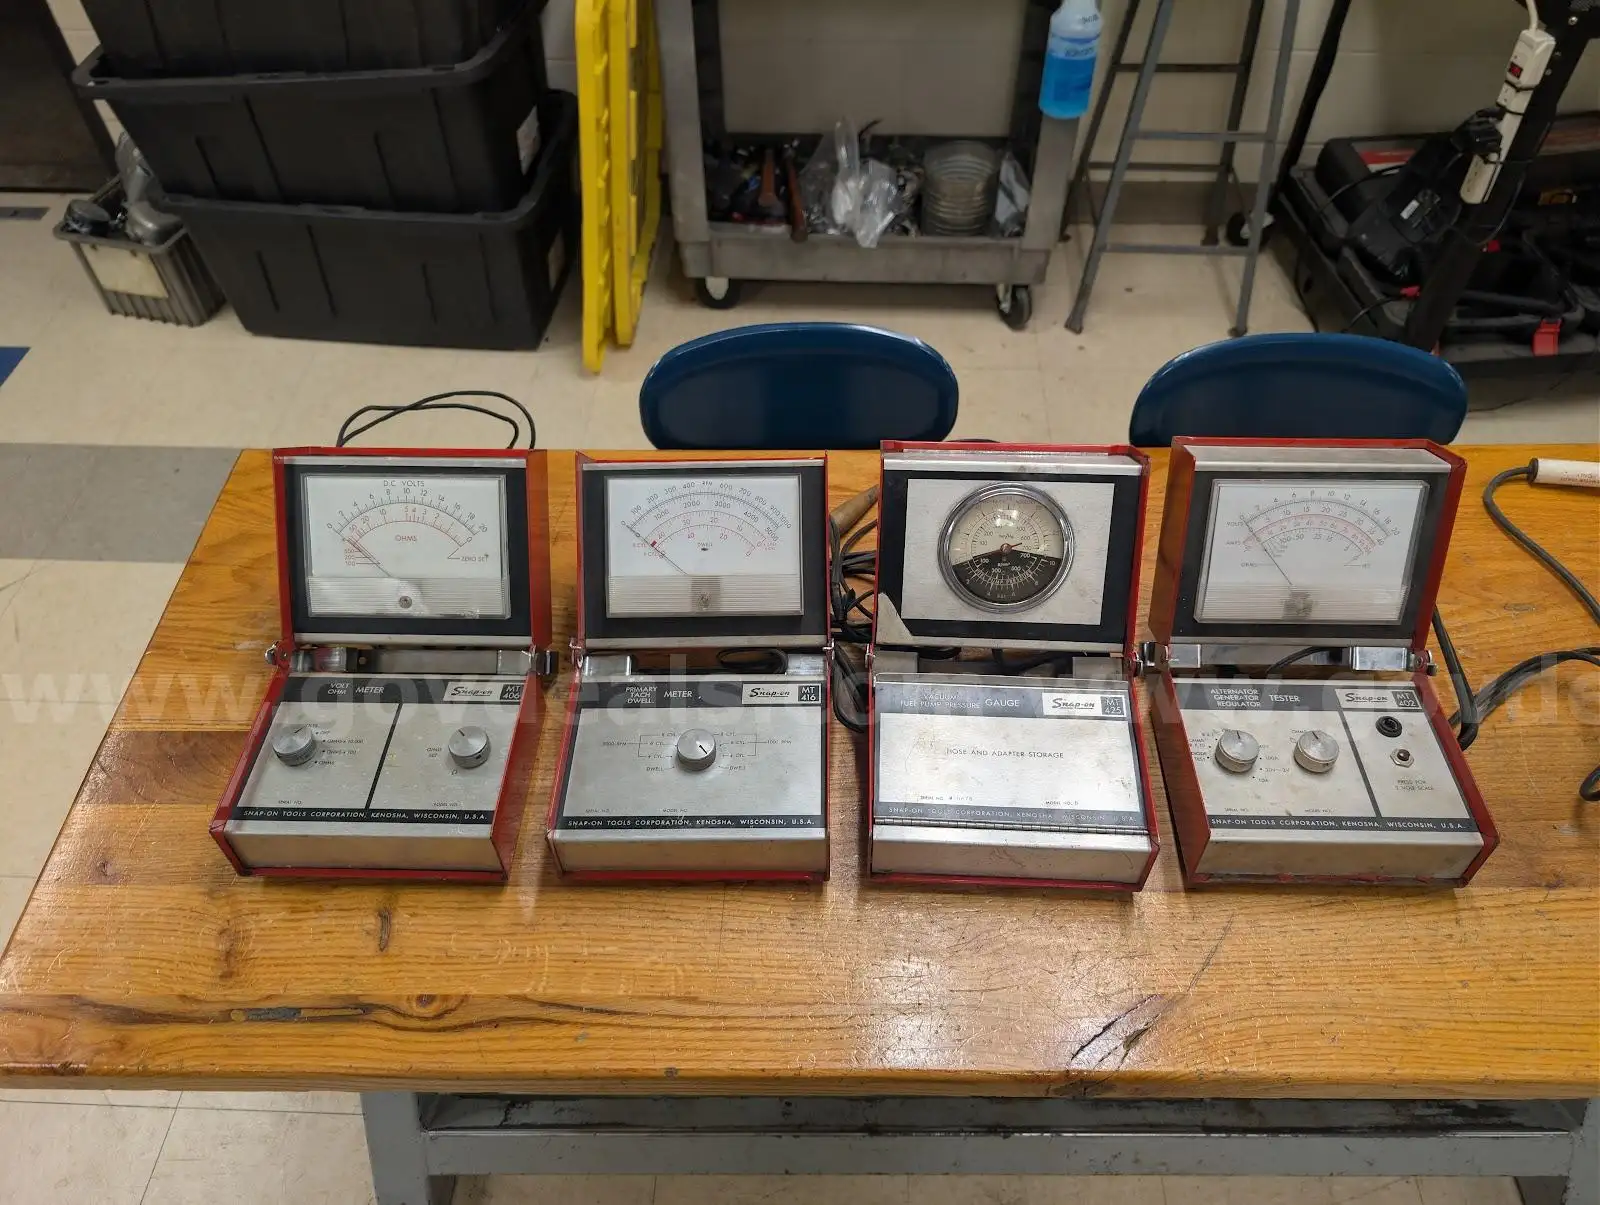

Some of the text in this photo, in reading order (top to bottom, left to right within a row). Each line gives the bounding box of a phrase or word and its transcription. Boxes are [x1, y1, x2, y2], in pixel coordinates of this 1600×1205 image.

[714, 500, 731, 509] 3000
[743, 510, 759, 523] 4000
[394, 534, 418, 542] OHMS
[355, 686, 385, 694] METER
[451, 686, 494, 697] Snap-on
[663, 690, 693, 698] METER
[749, 687, 791, 698] Snap-on
[801, 686, 816, 694] MT
[502, 692, 521, 700] 406
[800, 693, 817, 701] 416
[1268, 694, 1301, 702] TESTER
[1344, 692, 1389, 703] Snap-on
[984, 698, 1020, 707] GAUGE
[1052, 697, 1095, 710] Snap-on
[1106, 699, 1120, 707] MT
[1216, 700, 1261, 708] REGULATOR
[1104, 707, 1122, 715] 425
[946, 747, 967, 755] HOSE
[992, 749, 1026, 758] ADAPTER
[1028, 751, 1064, 759] STORAGE
[310, 811, 367, 819] CORPORATION,
[635, 819, 692, 827] CORPORATION,
[1279, 819, 1339, 827] CORPORATION,
[1386, 821, 1437, 829] WISCONSIN,
